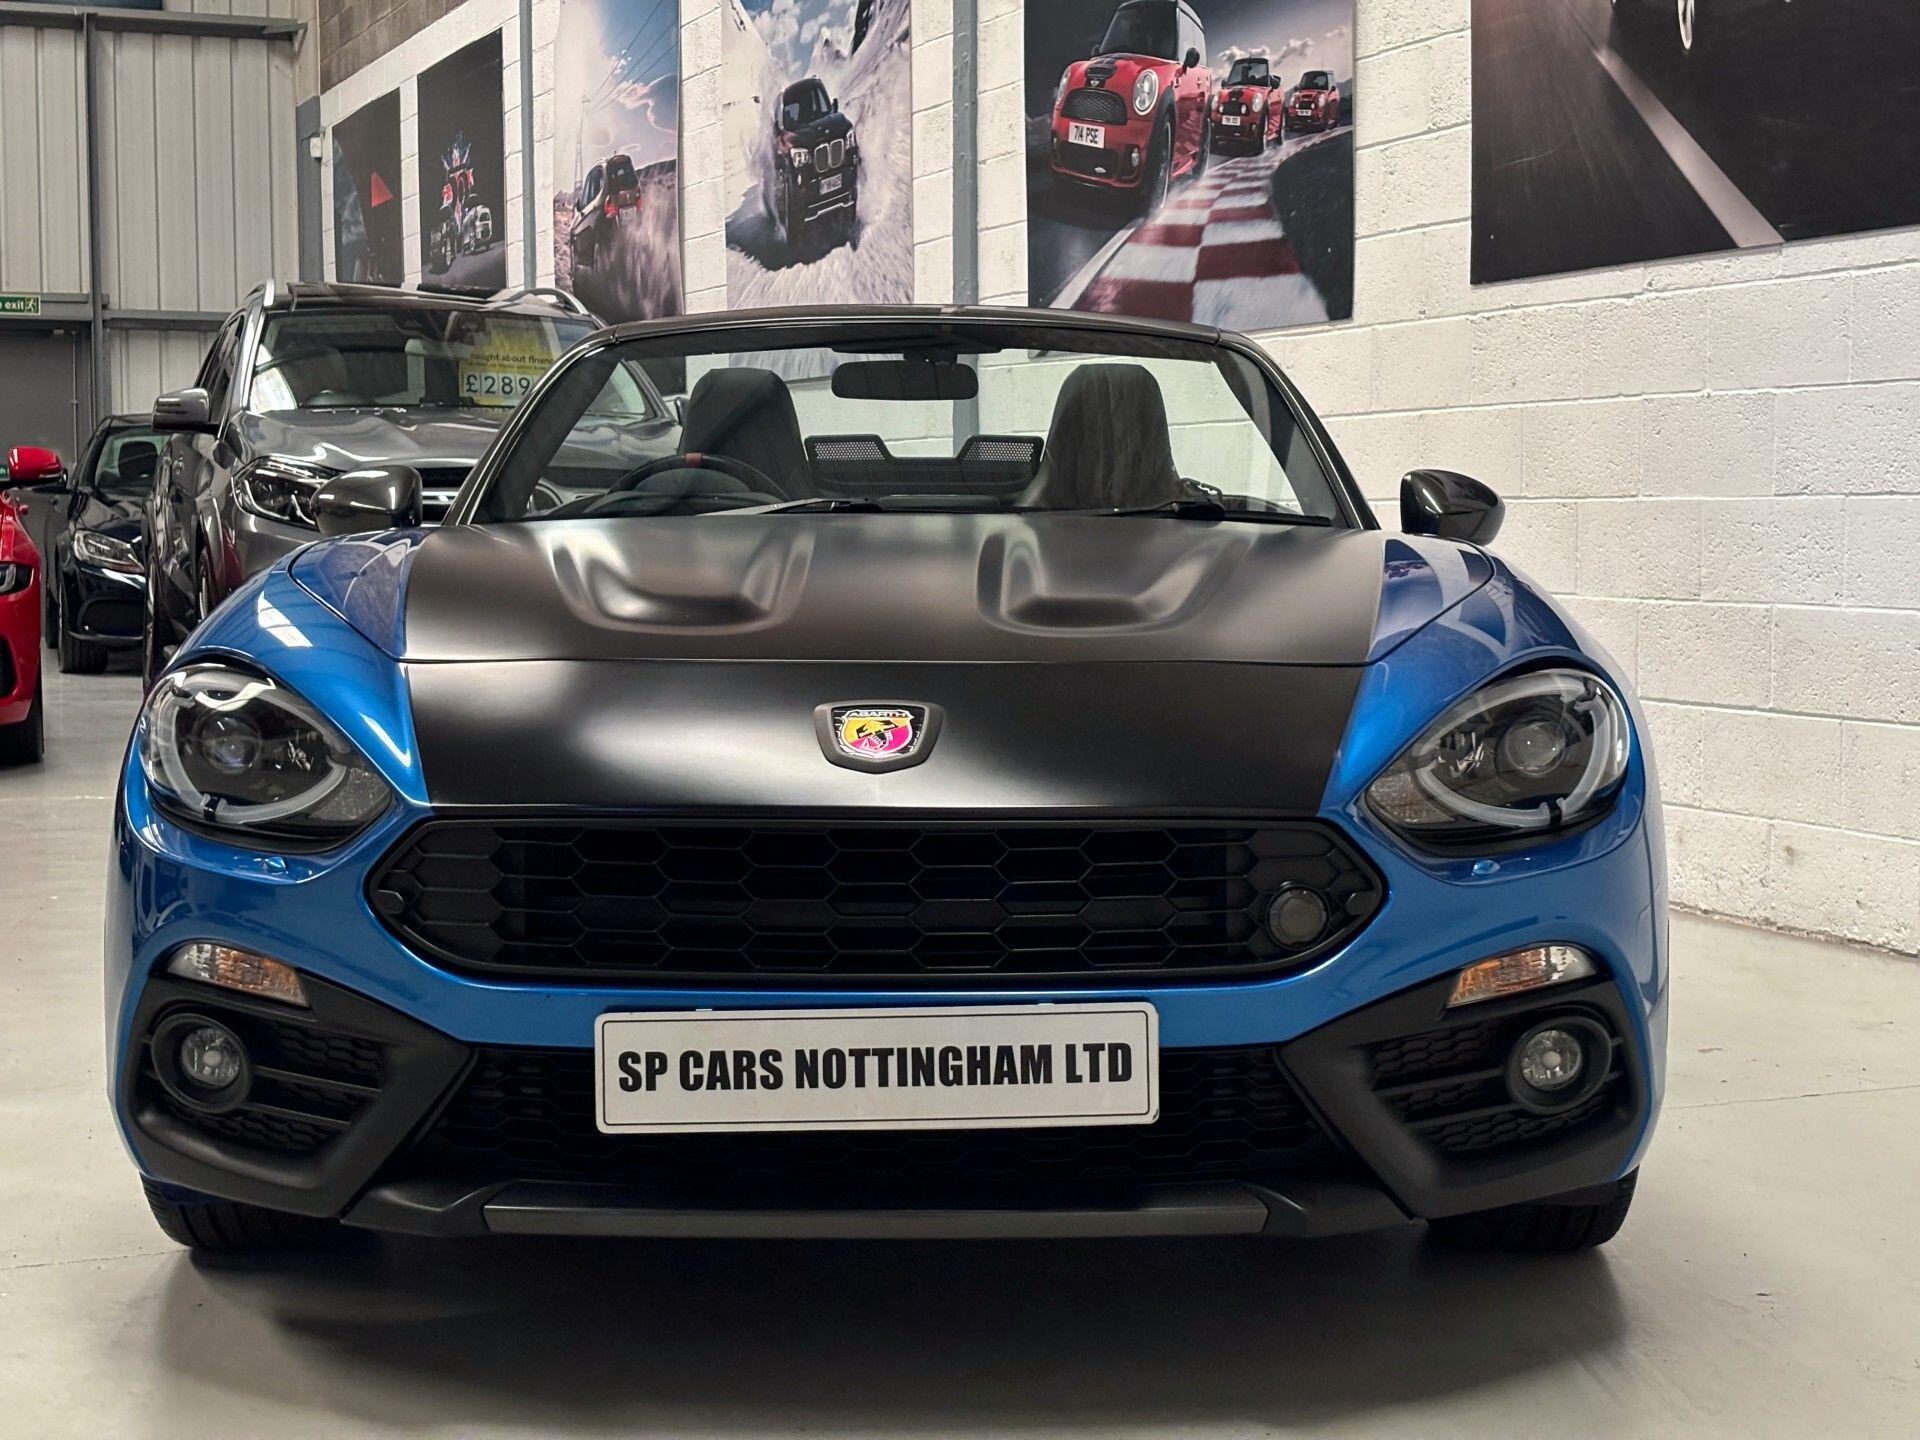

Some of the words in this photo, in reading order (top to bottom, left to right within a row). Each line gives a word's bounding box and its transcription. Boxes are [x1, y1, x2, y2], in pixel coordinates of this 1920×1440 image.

[1085, 126, 1099, 145] PSE
[5, 301, 24, 310] exit
[618, 1050, 668, 1092] SP
[679, 1048, 783, 1091] CARS
[794, 1044, 1053, 1089] NOTTINGHAM
[1065, 1042, 1133, 1083] LTD
